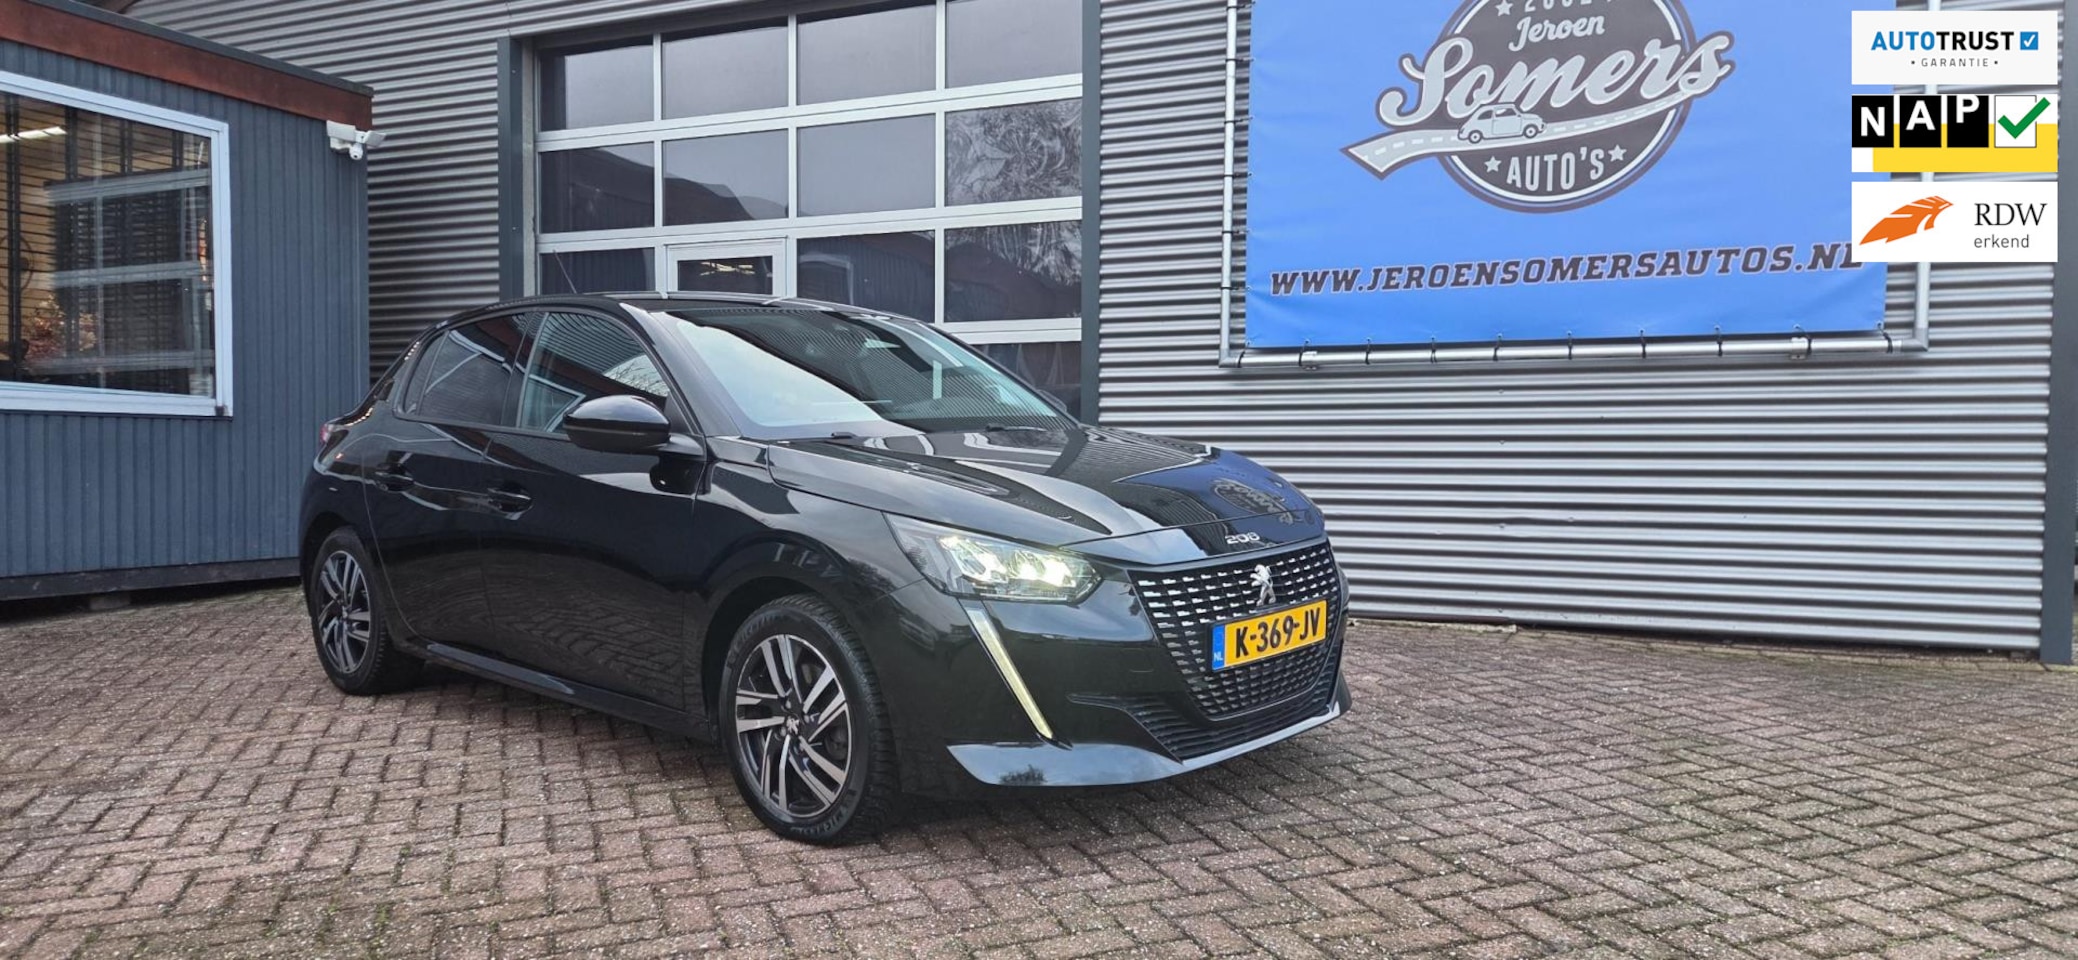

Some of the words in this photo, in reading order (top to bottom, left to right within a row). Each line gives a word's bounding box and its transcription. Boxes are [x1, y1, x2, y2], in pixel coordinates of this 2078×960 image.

[1508, 16, 1605, 52] Jeroen
[1379, 35, 1732, 127] Somers
[1506, 147, 1605, 192] AUTO'S
[1225, 531, 1260, 545] 208
[1235, 607, 1321, 659] K-369-JV
[1213, 651, 1224, 662] NL
